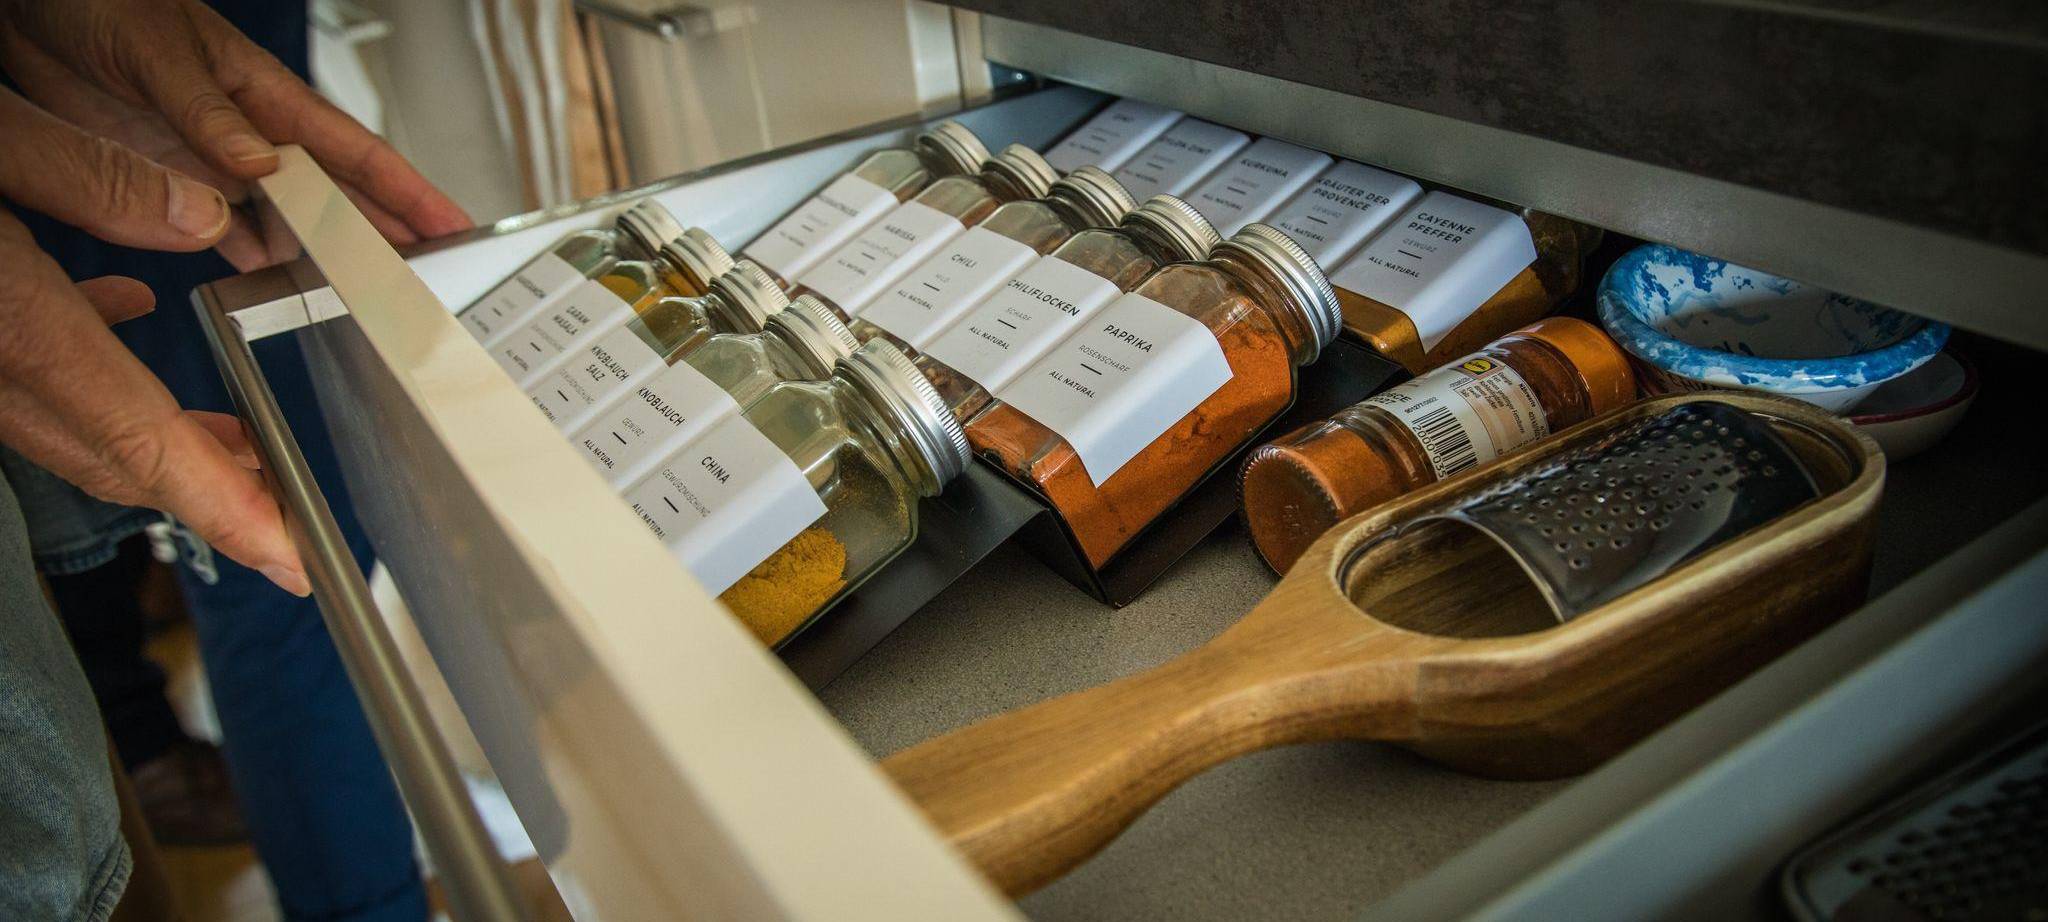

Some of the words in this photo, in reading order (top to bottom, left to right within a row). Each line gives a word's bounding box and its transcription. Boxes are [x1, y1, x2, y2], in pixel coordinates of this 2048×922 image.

[1240, 158, 1288, 178] KURKUMA
[1312, 188, 1372, 212] PROVENCE
[1317, 176, 1365, 198] KRÄUTER
[1365, 191, 1390, 206] DER
[884, 225, 916, 242] HARISSA
[1280, 222, 1292, 230] ALL
[1294, 227, 1325, 242] NATURAL
[1408, 222, 1462, 245] PFEFFER
[1417, 212, 1476, 236] CAYENNE
[952, 254, 976, 268] CHILI
[1368, 256, 1383, 266] ALL
[1384, 262, 1420, 278] NATURAL
[898, 289, 907, 298] ALL
[908, 294, 934, 310] NATURAL
[1007, 279, 1080, 316] CHILIFLOCKEN
[554, 314, 579, 336] MASALA
[566, 306, 590, 326] GARAM
[970, 326, 982, 336] ALL
[981, 332, 1010, 350] NATURAL
[1104, 324, 1152, 352] PAPRIKA
[592, 346, 630, 382] KNOBLAUCH
[1078, 344, 1131, 373] ROSENSCHARF
[586, 364, 606, 382] SALZ
[1049, 370, 1064, 382] ALL
[1064, 377, 1096, 399] NATURAL
[636, 387, 686, 427] KNOBLAUCH
[622, 418, 644, 436] GEWÜRZ
[1412, 425, 1436, 452] 2000
[584, 440, 594, 450] ALL
[592, 447, 616, 470] NATURAL
[702, 456, 730, 484] CHINA
[662, 468, 711, 518] GEWÜRZMISCHUNG
[632, 504, 642, 516] ALL
[642, 513, 666, 540] NATURAL
